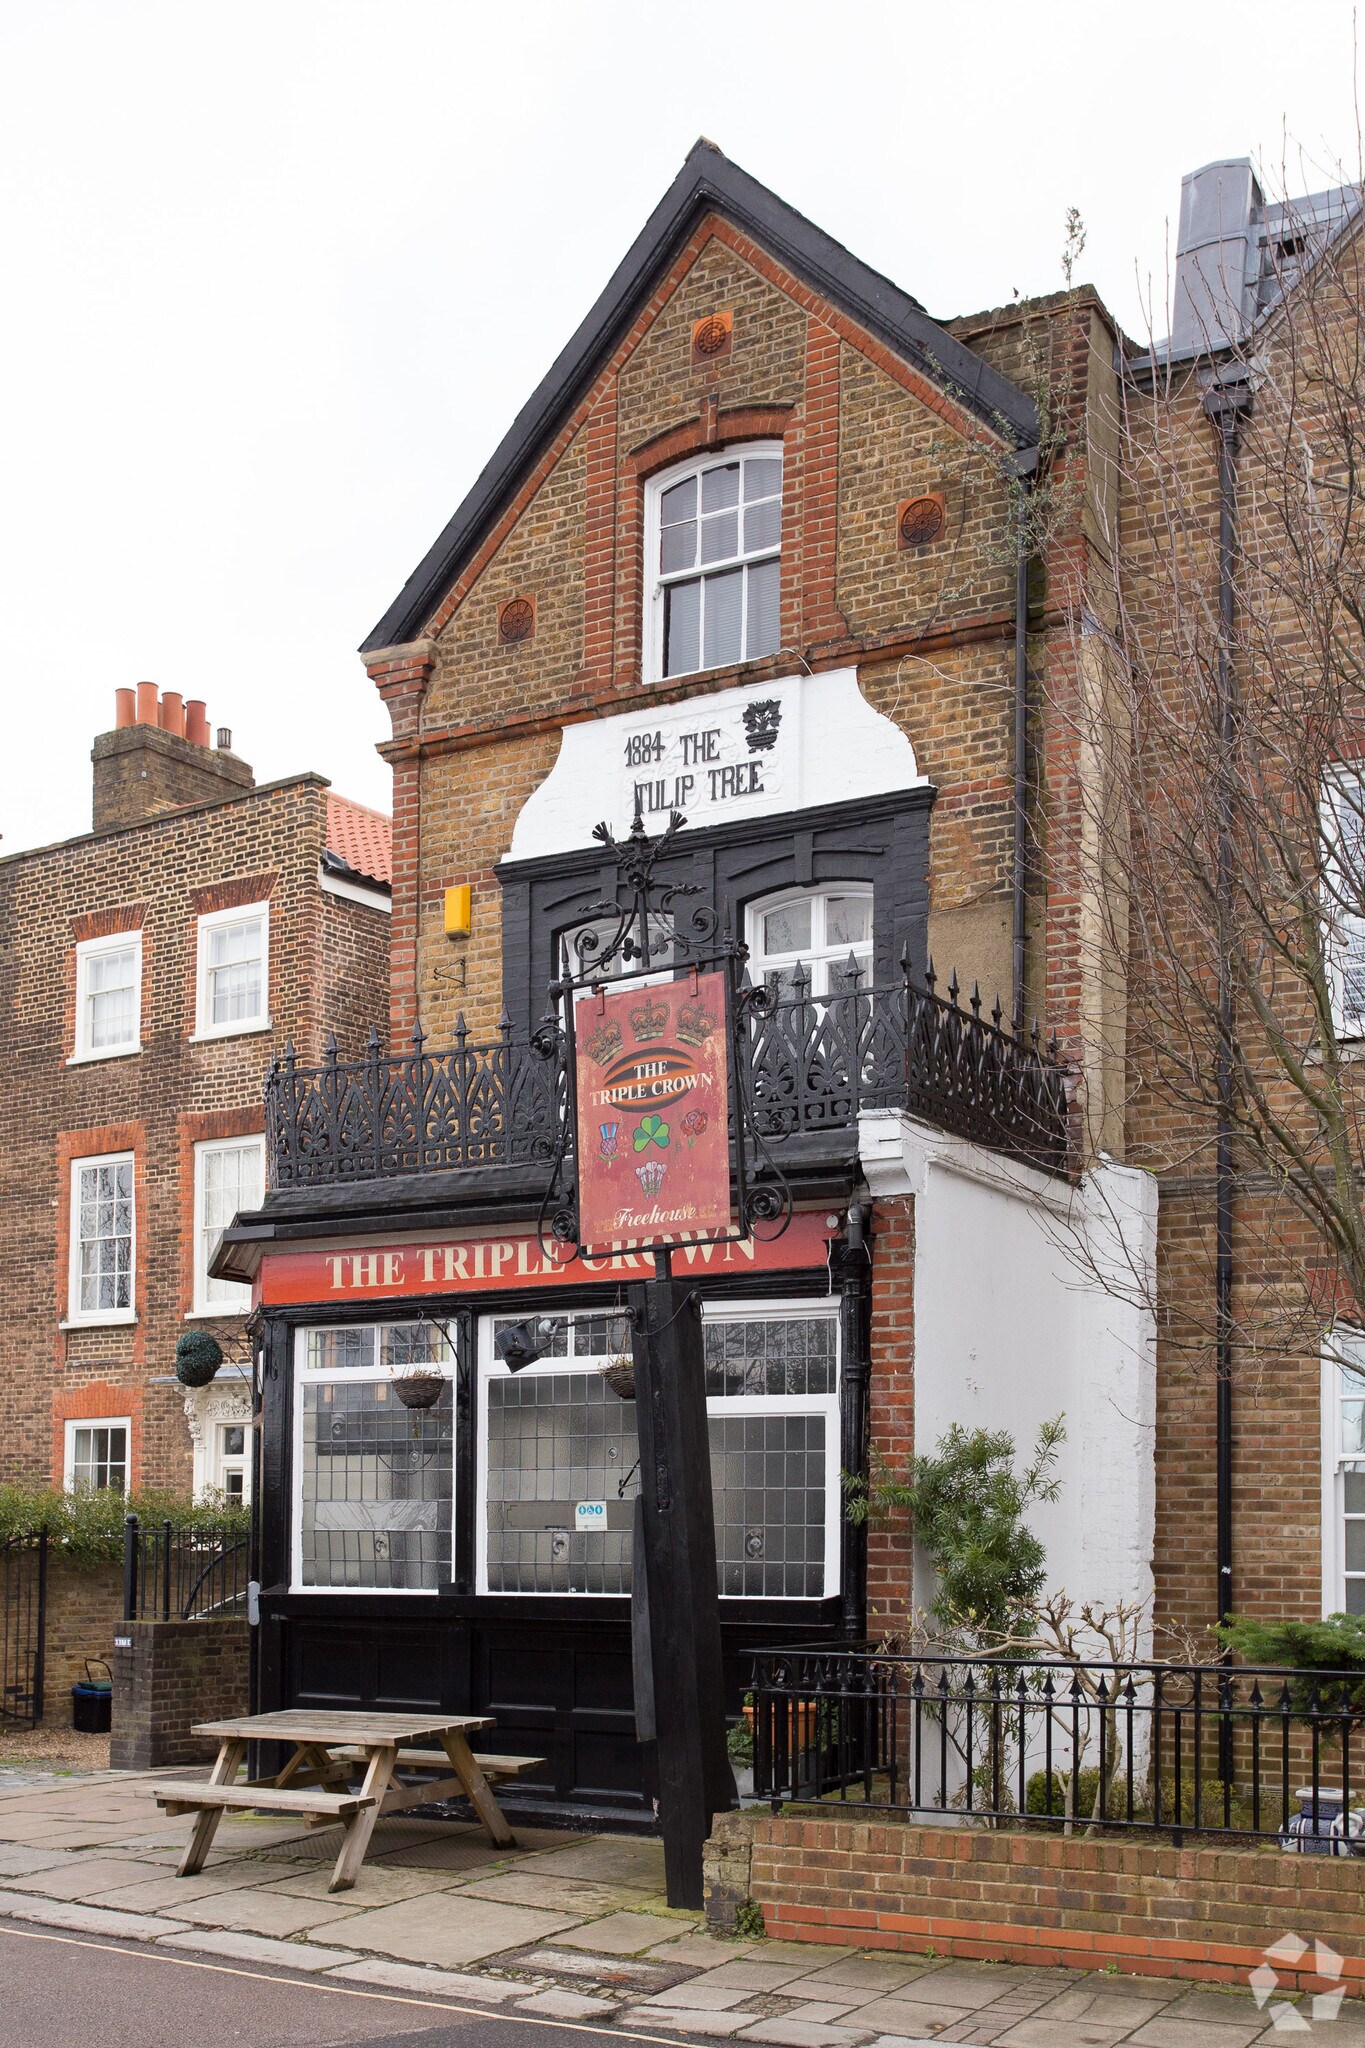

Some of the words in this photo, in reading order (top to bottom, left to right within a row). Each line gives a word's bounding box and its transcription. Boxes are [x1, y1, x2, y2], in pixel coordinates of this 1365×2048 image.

[624, 730, 666, 768] 1884
[679, 728, 721, 766] THE
[634, 774, 695, 814] TULIP
[707, 760, 765, 801] TREE
[589, 1083, 647, 1107] TRIPLE
[651, 1071, 713, 1096] CROWN
[633, 1060, 668, 1080] THE
[612, 1204, 697, 1230] Freehouse
[326, 1251, 406, 1290] THE
[416, 1238, 567, 1283] TRIPLE
